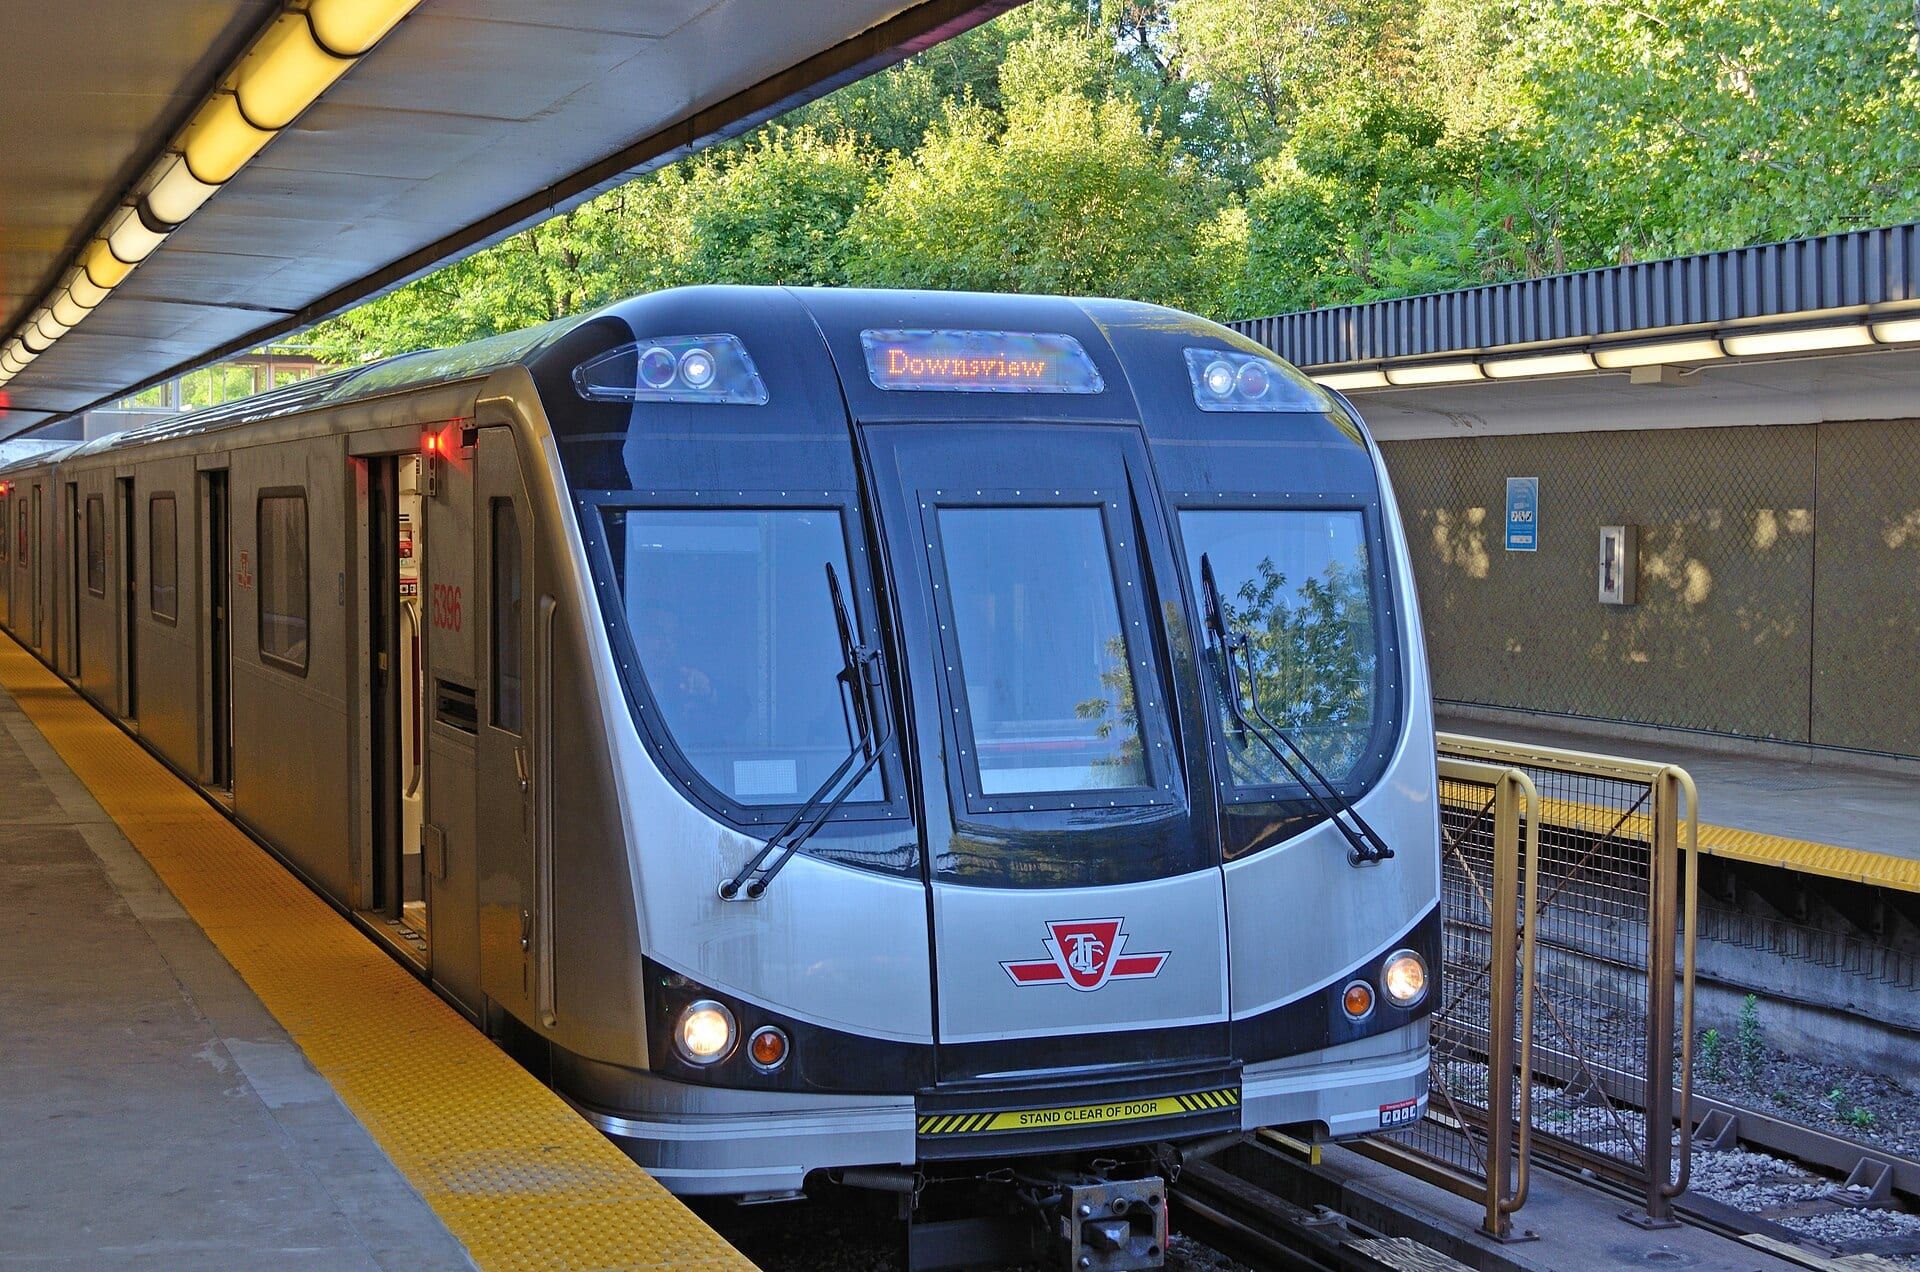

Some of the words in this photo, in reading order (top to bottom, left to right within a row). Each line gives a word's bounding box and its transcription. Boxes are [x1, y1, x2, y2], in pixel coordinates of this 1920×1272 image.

[888, 349, 1045, 377] Downsview
[432, 583, 462, 632] 5396
[1020, 1112, 1060, 1124] STAND
[1063, 1108, 1103, 1121] CLEAR
[1106, 1107, 1121, 1117] OF
[1125, 1103, 1157, 1115] DOOR
